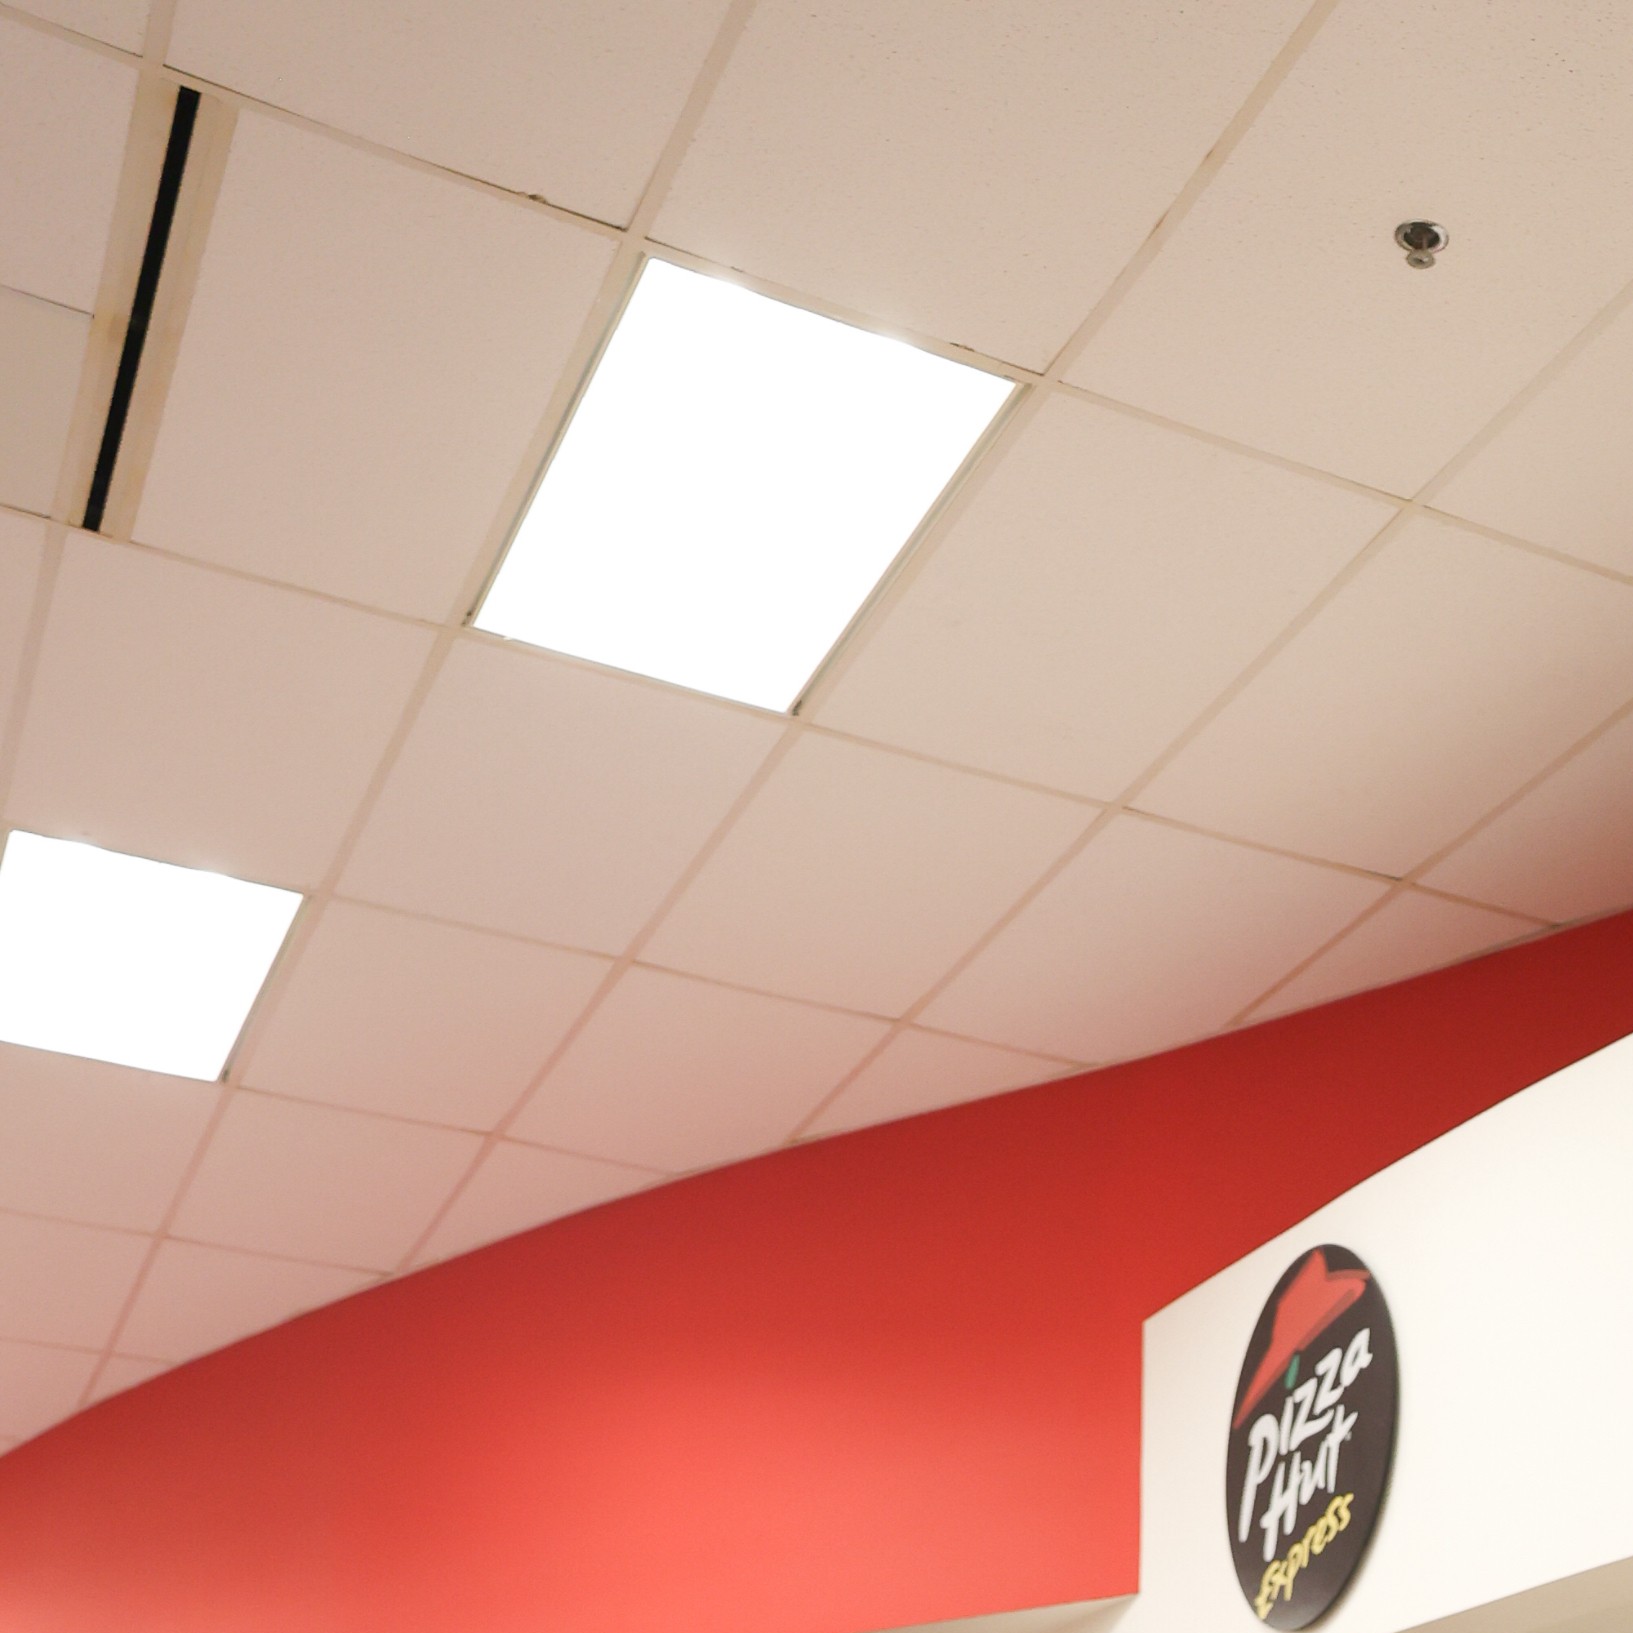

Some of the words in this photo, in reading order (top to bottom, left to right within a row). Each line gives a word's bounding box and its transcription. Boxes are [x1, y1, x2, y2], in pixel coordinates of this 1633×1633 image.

[1238, 1327, 1374, 1544] Pizza
[1260, 1405, 1359, 1562] Hut
[1255, 1492, 1355, 1620] Express
